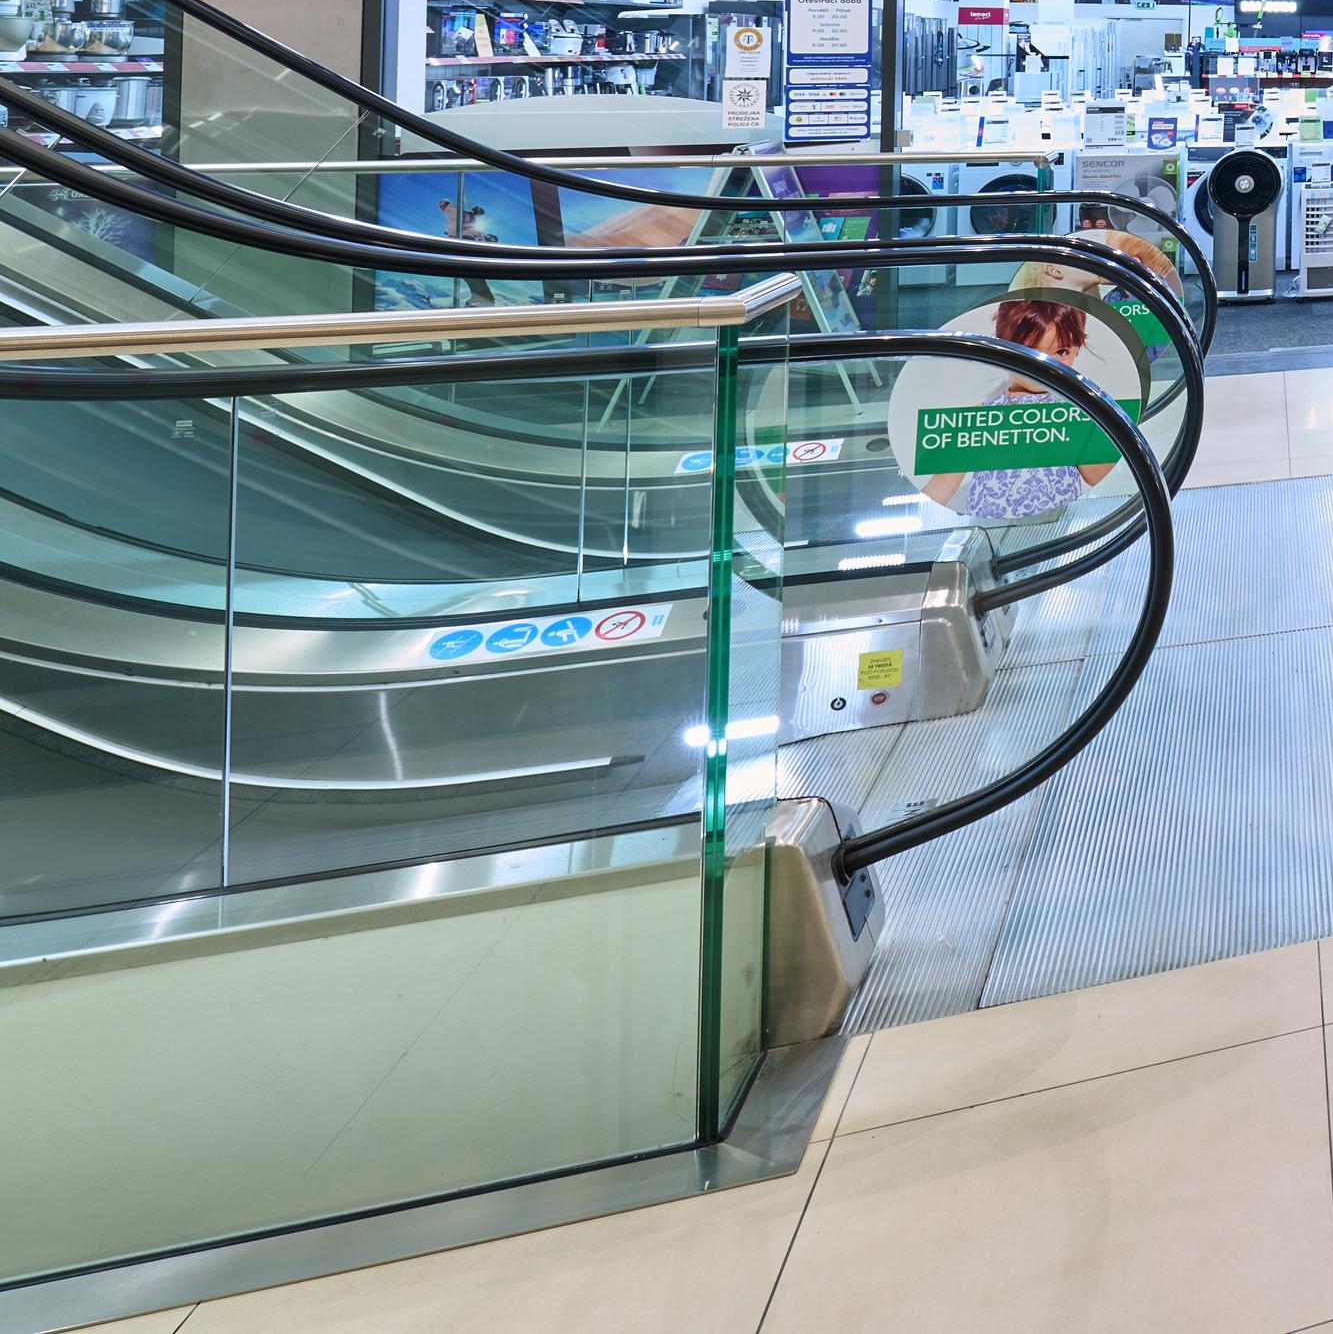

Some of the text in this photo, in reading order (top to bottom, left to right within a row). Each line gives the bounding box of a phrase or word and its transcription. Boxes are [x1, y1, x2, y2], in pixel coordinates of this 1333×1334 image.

[1082, 160, 1126, 168] SENCOR
[923, 410, 1003, 430] UNITED
[922, 426, 1069, 449] OF BENETTON.
